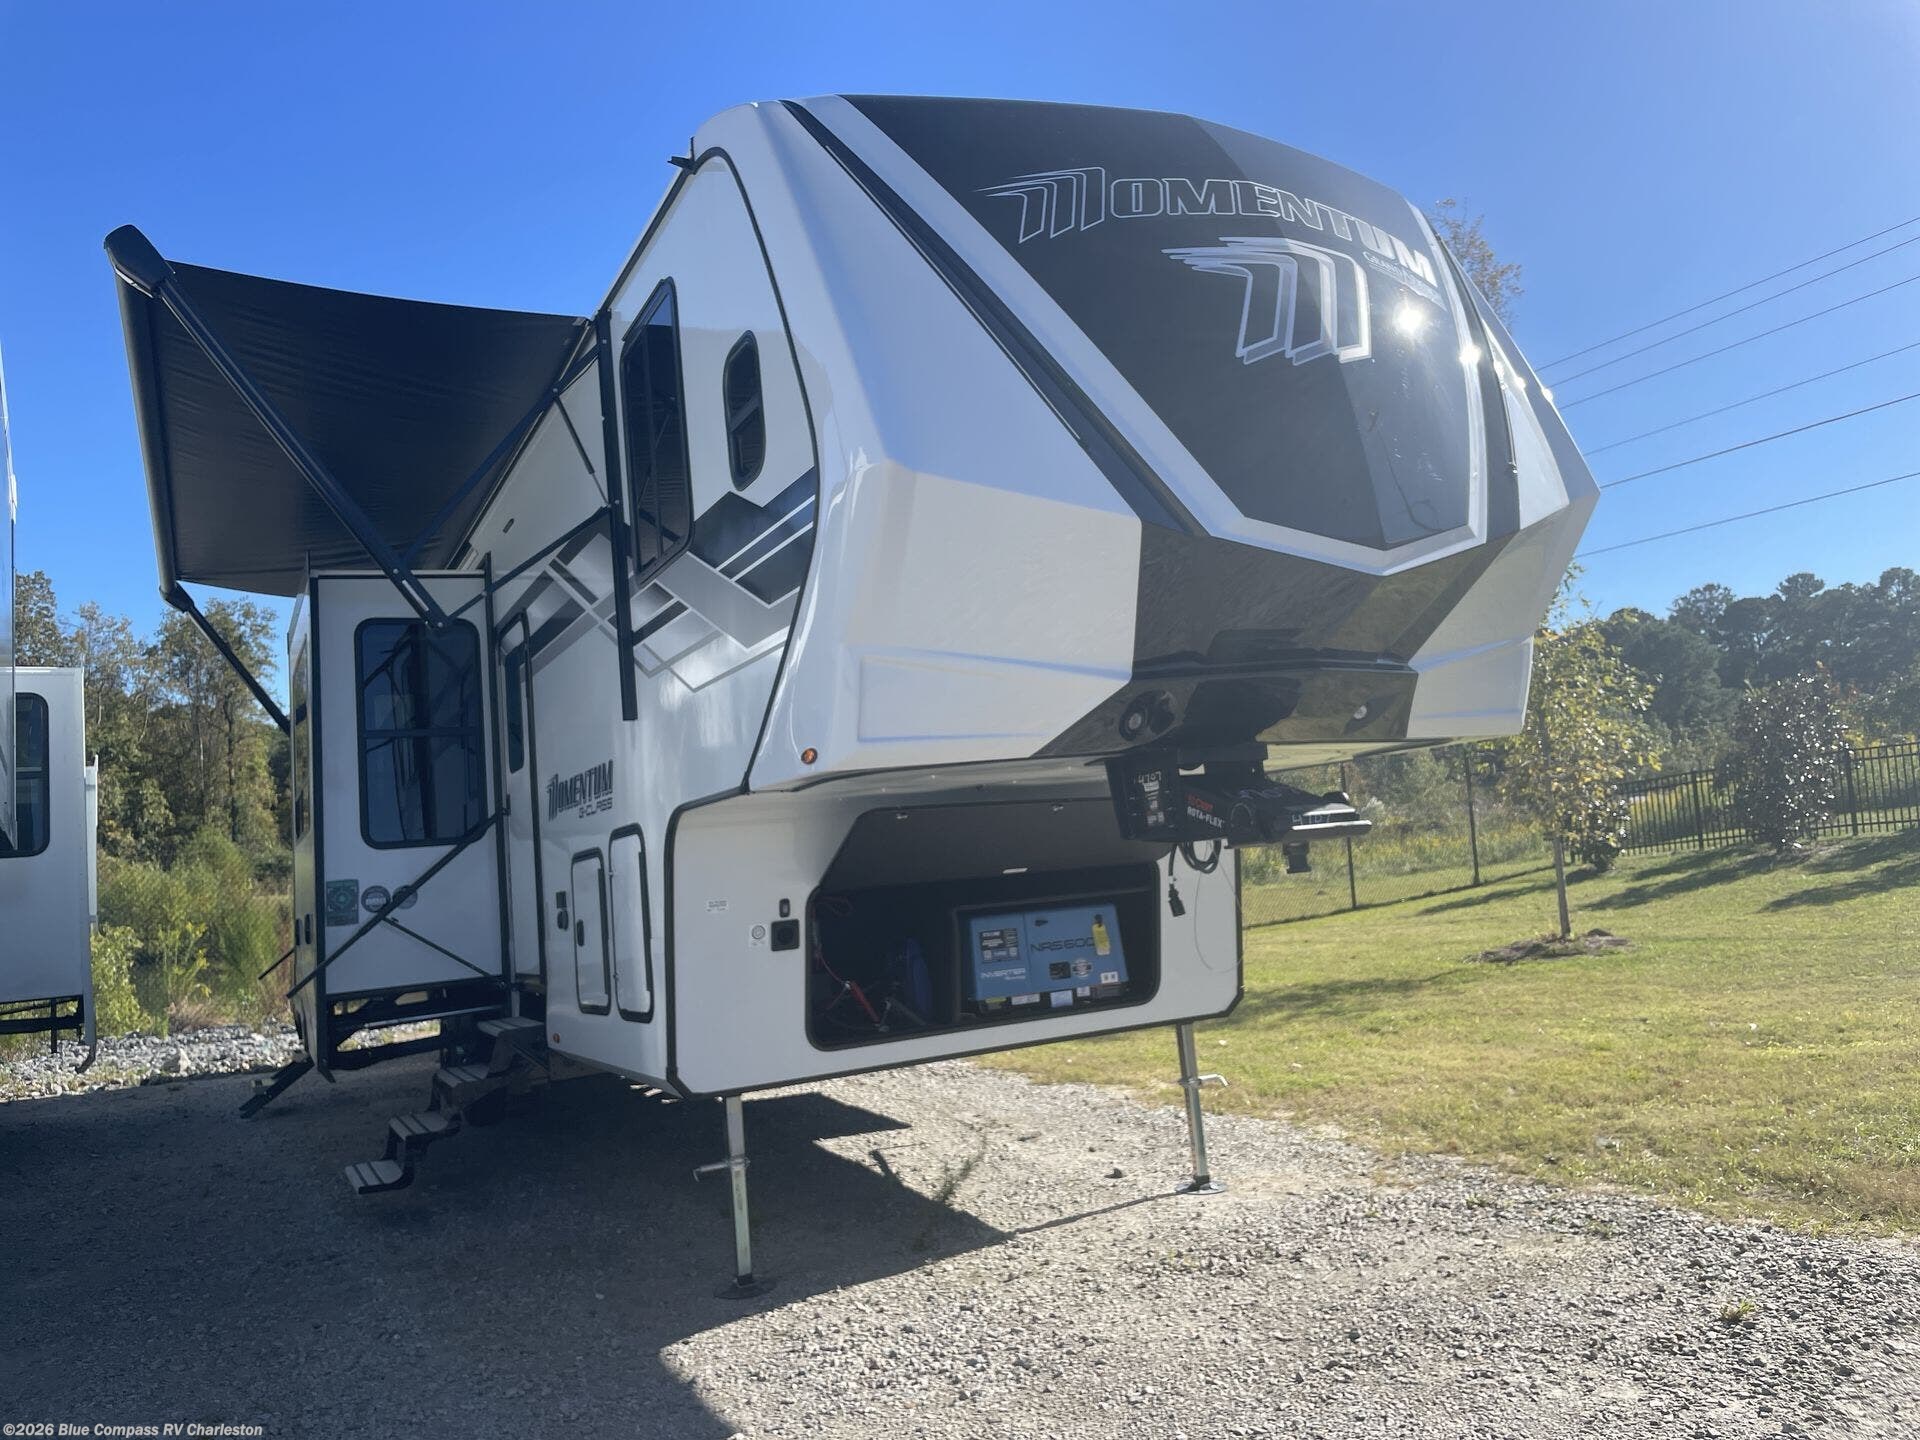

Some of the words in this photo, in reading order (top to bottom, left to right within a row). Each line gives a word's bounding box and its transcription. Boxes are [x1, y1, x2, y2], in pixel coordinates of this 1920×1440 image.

[973, 167, 1438, 288] MOMENTUM
[546, 759, 613, 821] MOMENTUM
[579, 797, 613, 819] G-CLASS
[1187, 806, 1222, 828] ROTA-FLEX
